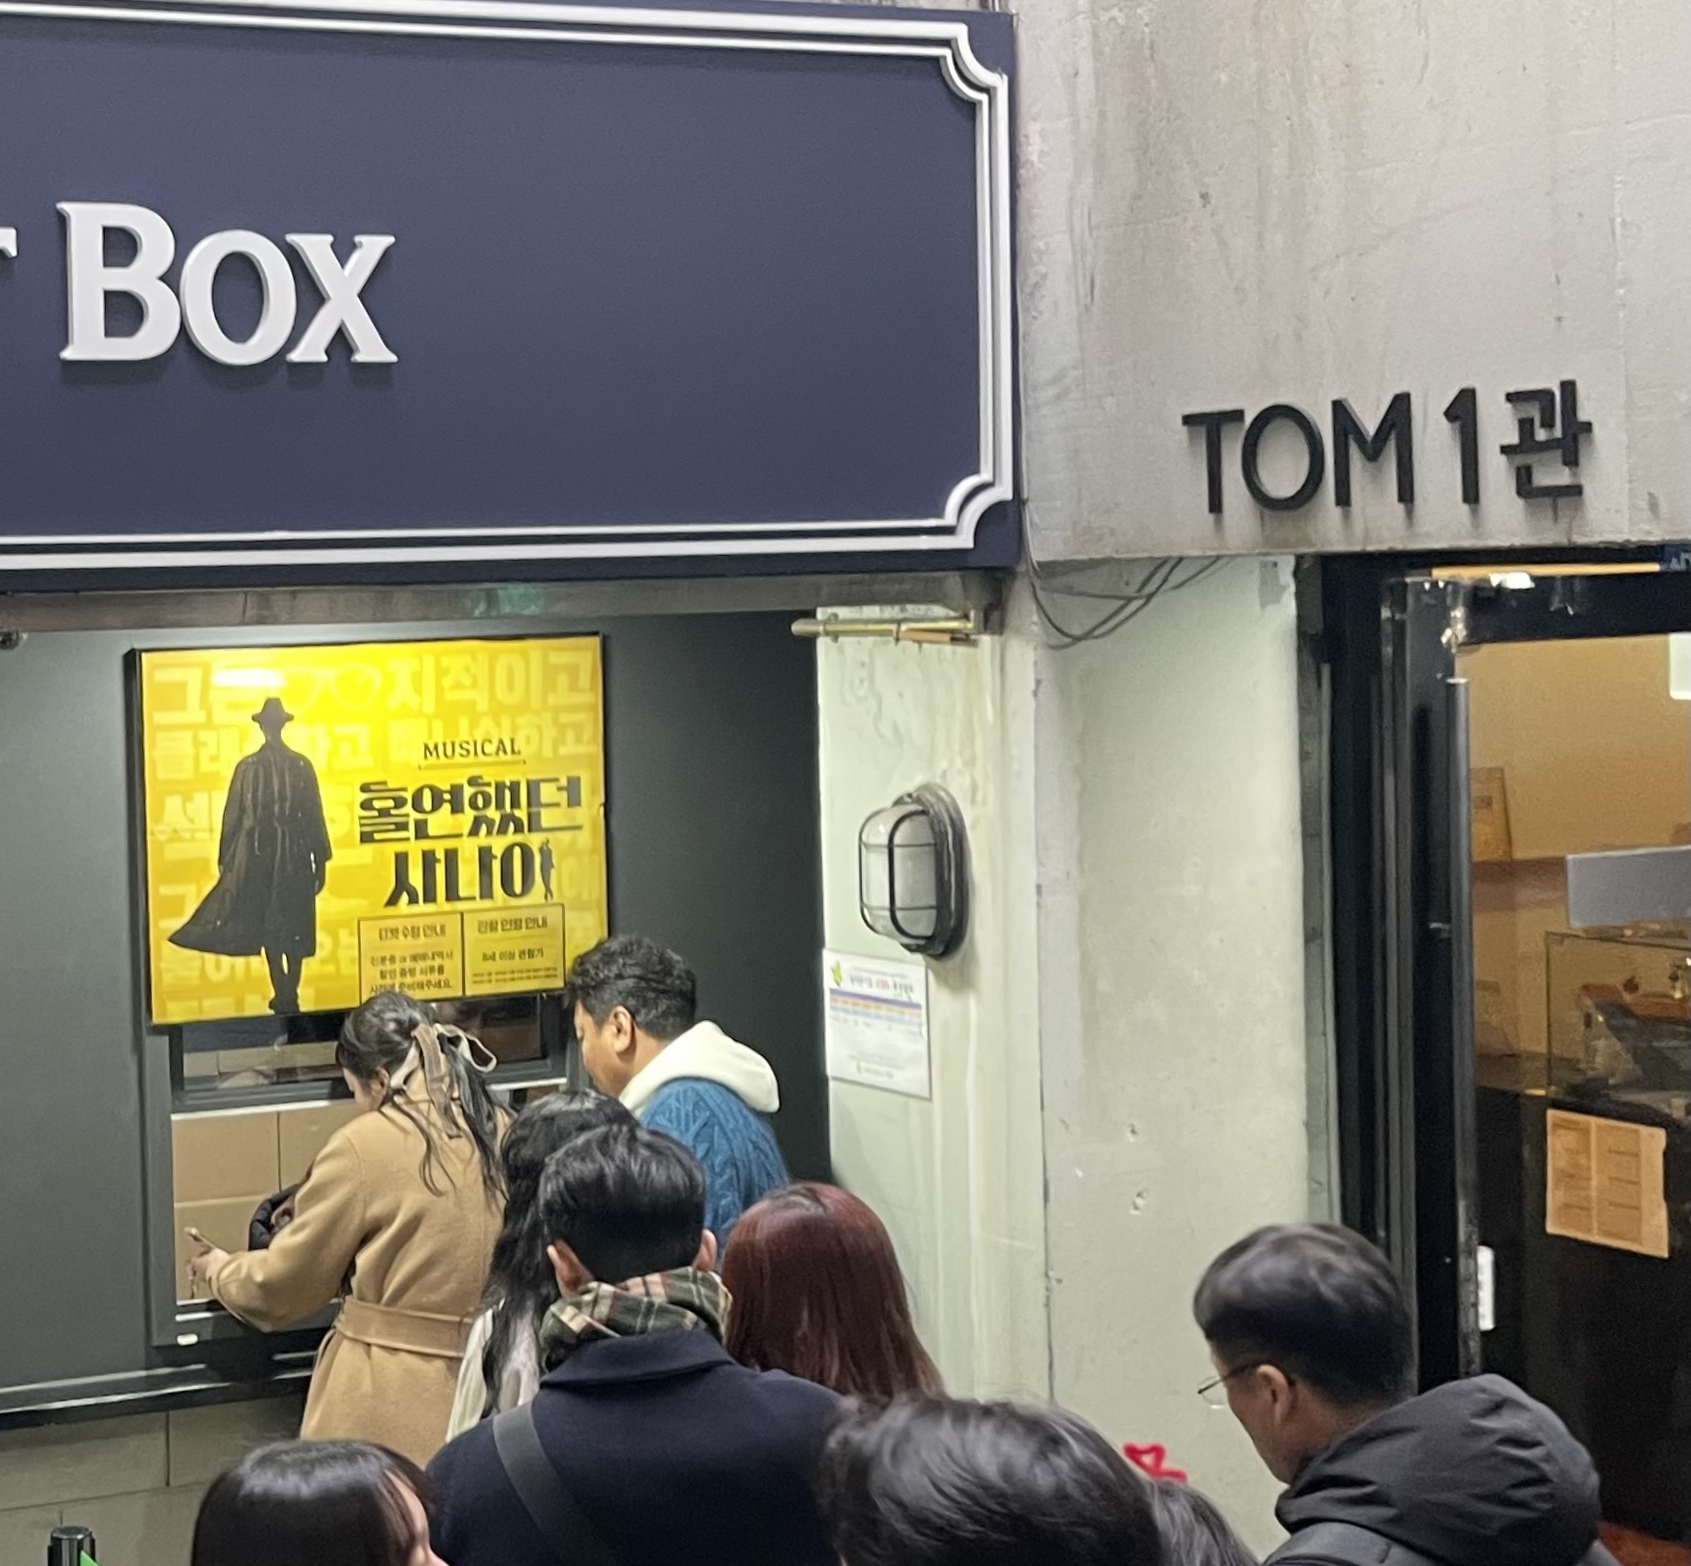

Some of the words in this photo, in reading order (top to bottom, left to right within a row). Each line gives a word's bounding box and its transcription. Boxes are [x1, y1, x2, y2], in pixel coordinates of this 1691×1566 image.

[58, 200, 398, 365] BOX
[1182, 391, 1415, 514] TOM
[1443, 379, 1593, 505] 1관
[423, 737, 522, 761] MUSICAL
[358, 774, 585, 844] 홀연했던
[383, 837, 555, 908] 사나이
